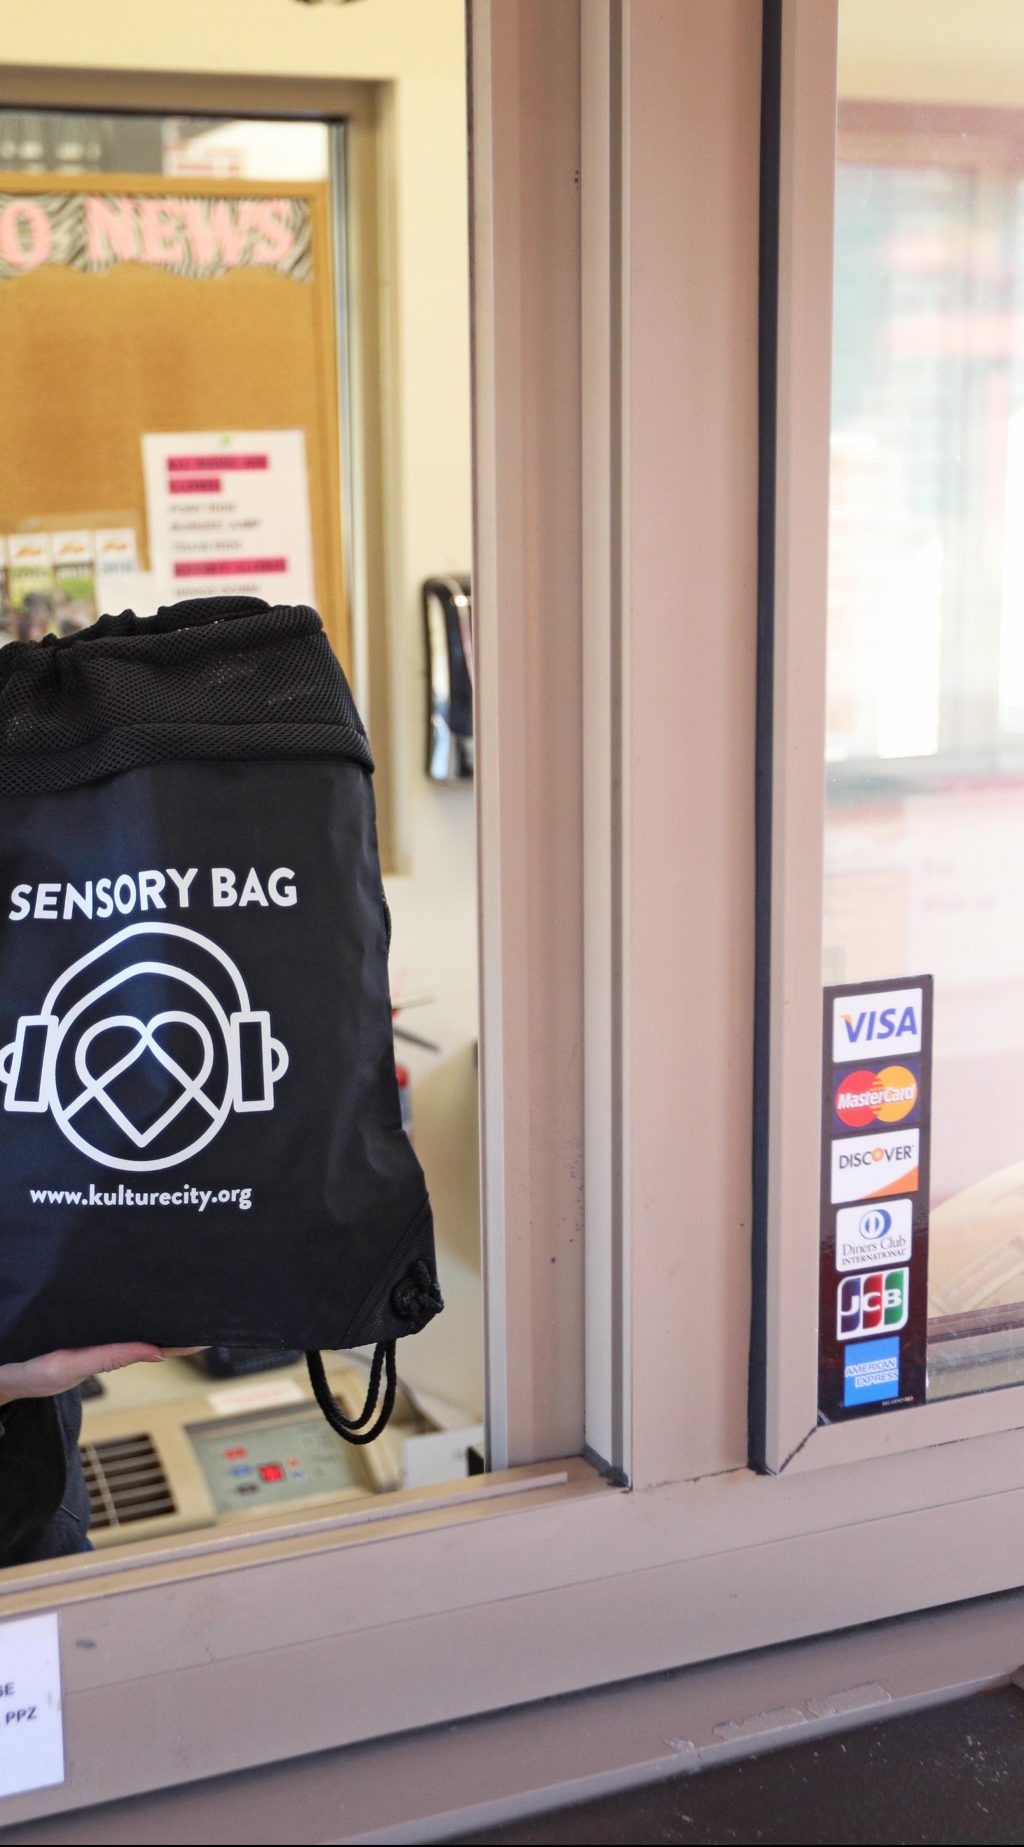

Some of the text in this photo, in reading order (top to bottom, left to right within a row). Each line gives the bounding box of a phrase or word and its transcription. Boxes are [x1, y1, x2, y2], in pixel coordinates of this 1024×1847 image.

[84, 194, 293, 264] NEWS
[8, 867, 298, 921] SENSORY BAG
[840, 1006, 918, 1043] VISA
[837, 1083, 916, 1110] MasterCard
[838, 1145, 913, 1169] DISCOVER
[29, 1184, 252, 1211] www.kulturecity.org
[841, 1249, 905, 1265] INTERNATIONAL
[842, 1234, 906, 1257] Diners Club
[841, 1288, 902, 1315] JCB
[846, 1359, 897, 1376] AMERICAN
[856, 1371, 899, 1386] EXPRESS
[5, 1706, 38, 1726] PPZ
